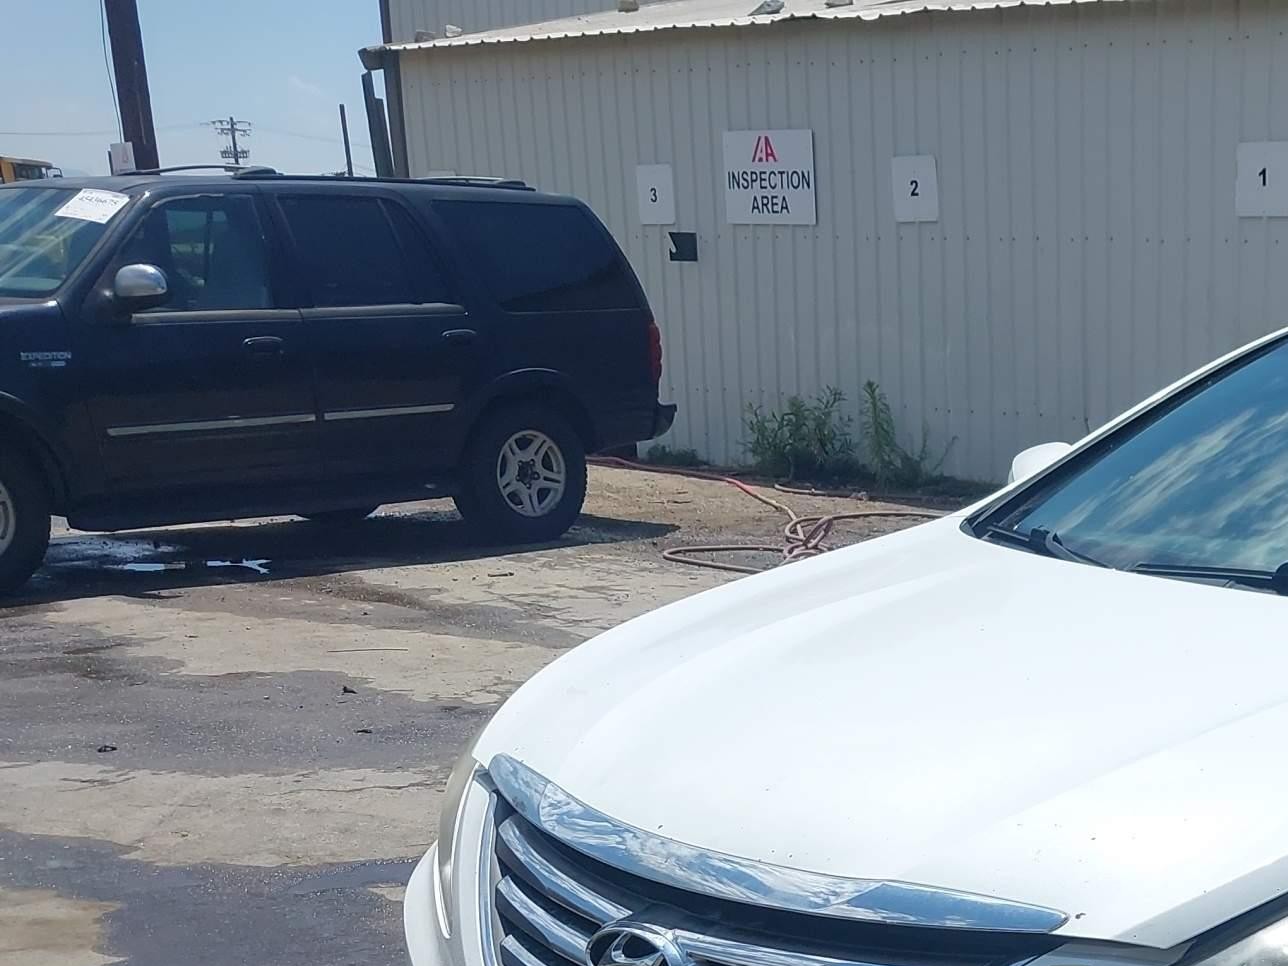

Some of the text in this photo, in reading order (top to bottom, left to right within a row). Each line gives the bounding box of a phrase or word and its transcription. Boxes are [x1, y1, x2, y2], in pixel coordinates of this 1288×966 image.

[727, 170, 811, 190] INSPECTION
[1258, 167, 1267, 187] 1
[650, 187, 658, 203] 3
[910, 179, 920, 197] 2
[751, 195, 791, 215] AREA
